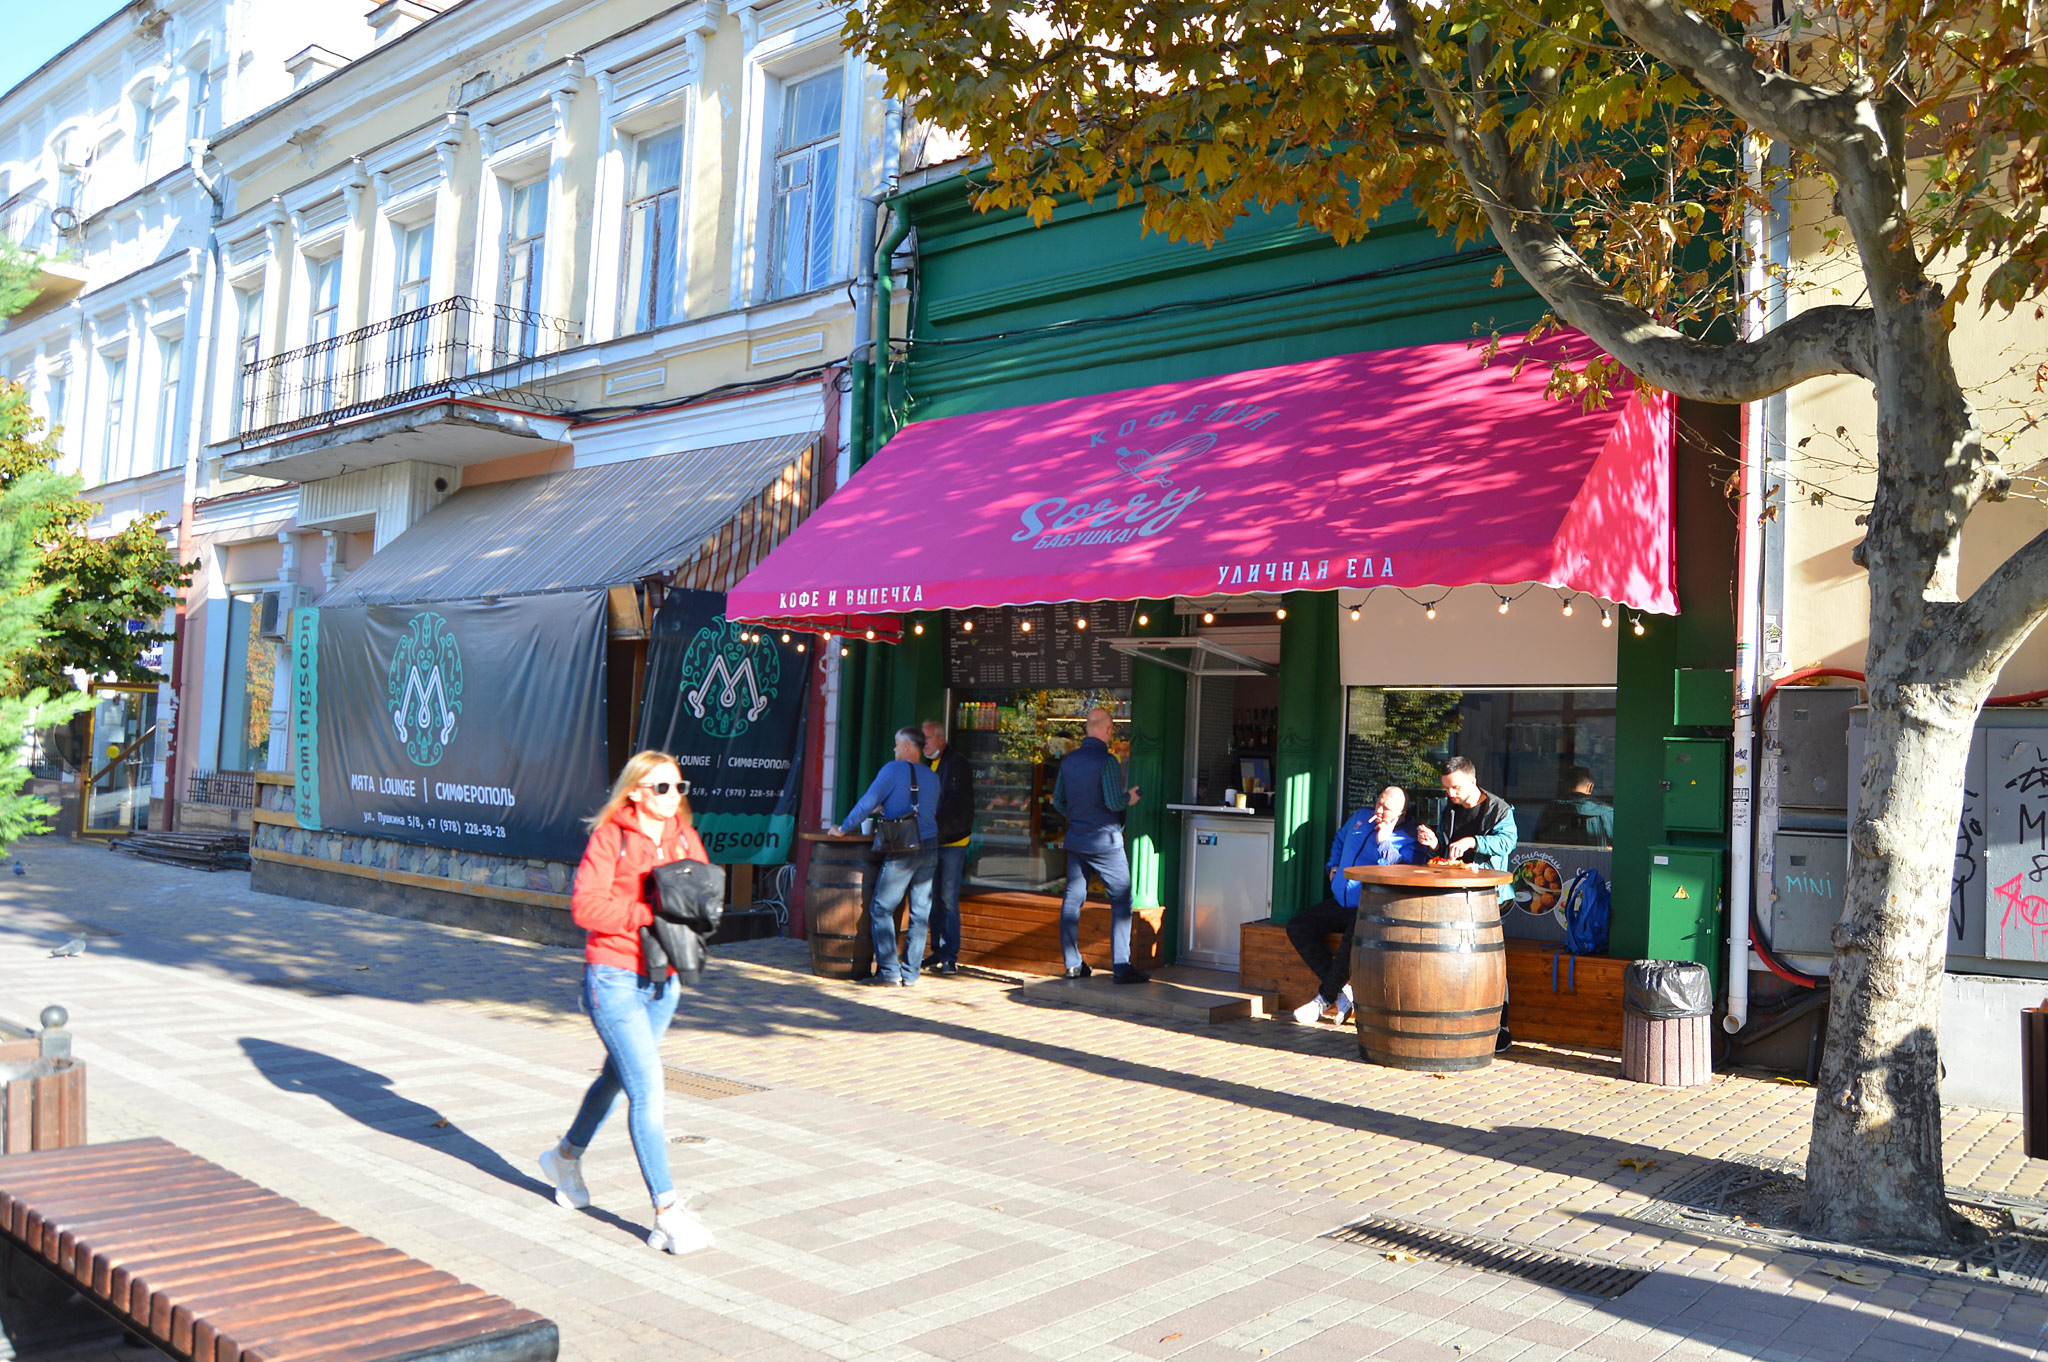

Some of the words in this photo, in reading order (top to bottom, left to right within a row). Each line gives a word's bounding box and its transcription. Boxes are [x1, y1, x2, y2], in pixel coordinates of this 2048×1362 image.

[1090, 401, 1280, 447] КОФЕЙНЯ
[1011, 486, 1207, 542] Sorry
[1033, 528, 1137, 550] БАБУШКА!
[1217, 560, 1329, 585] УЛИЧНАЯ
[1346, 557, 1394, 579] ЕДА
[779, 590, 820, 609] КОФЕ
[828, 590, 838, 607] И
[846, 584, 923, 606] ВЫПЕЧКА
[296, 614, 312, 820] #comingsoon
[728, 757, 791, 770] СИМФЕРОПОЛЬ
[351, 773, 375, 793] МЯТА
[379, 777, 416, 798] LOUNGE
[435, 782, 516, 807] СИМФЕРОПОЛЬ
[363, 811, 375, 823] ул.
[377, 811, 405, 826] Пушкина
[407, 815, 424, 830] 5/8,
[427, 818, 436, 830] +7
[439, 818, 461, 835] (978)
[464, 822, 506, 838] 228-58-28
